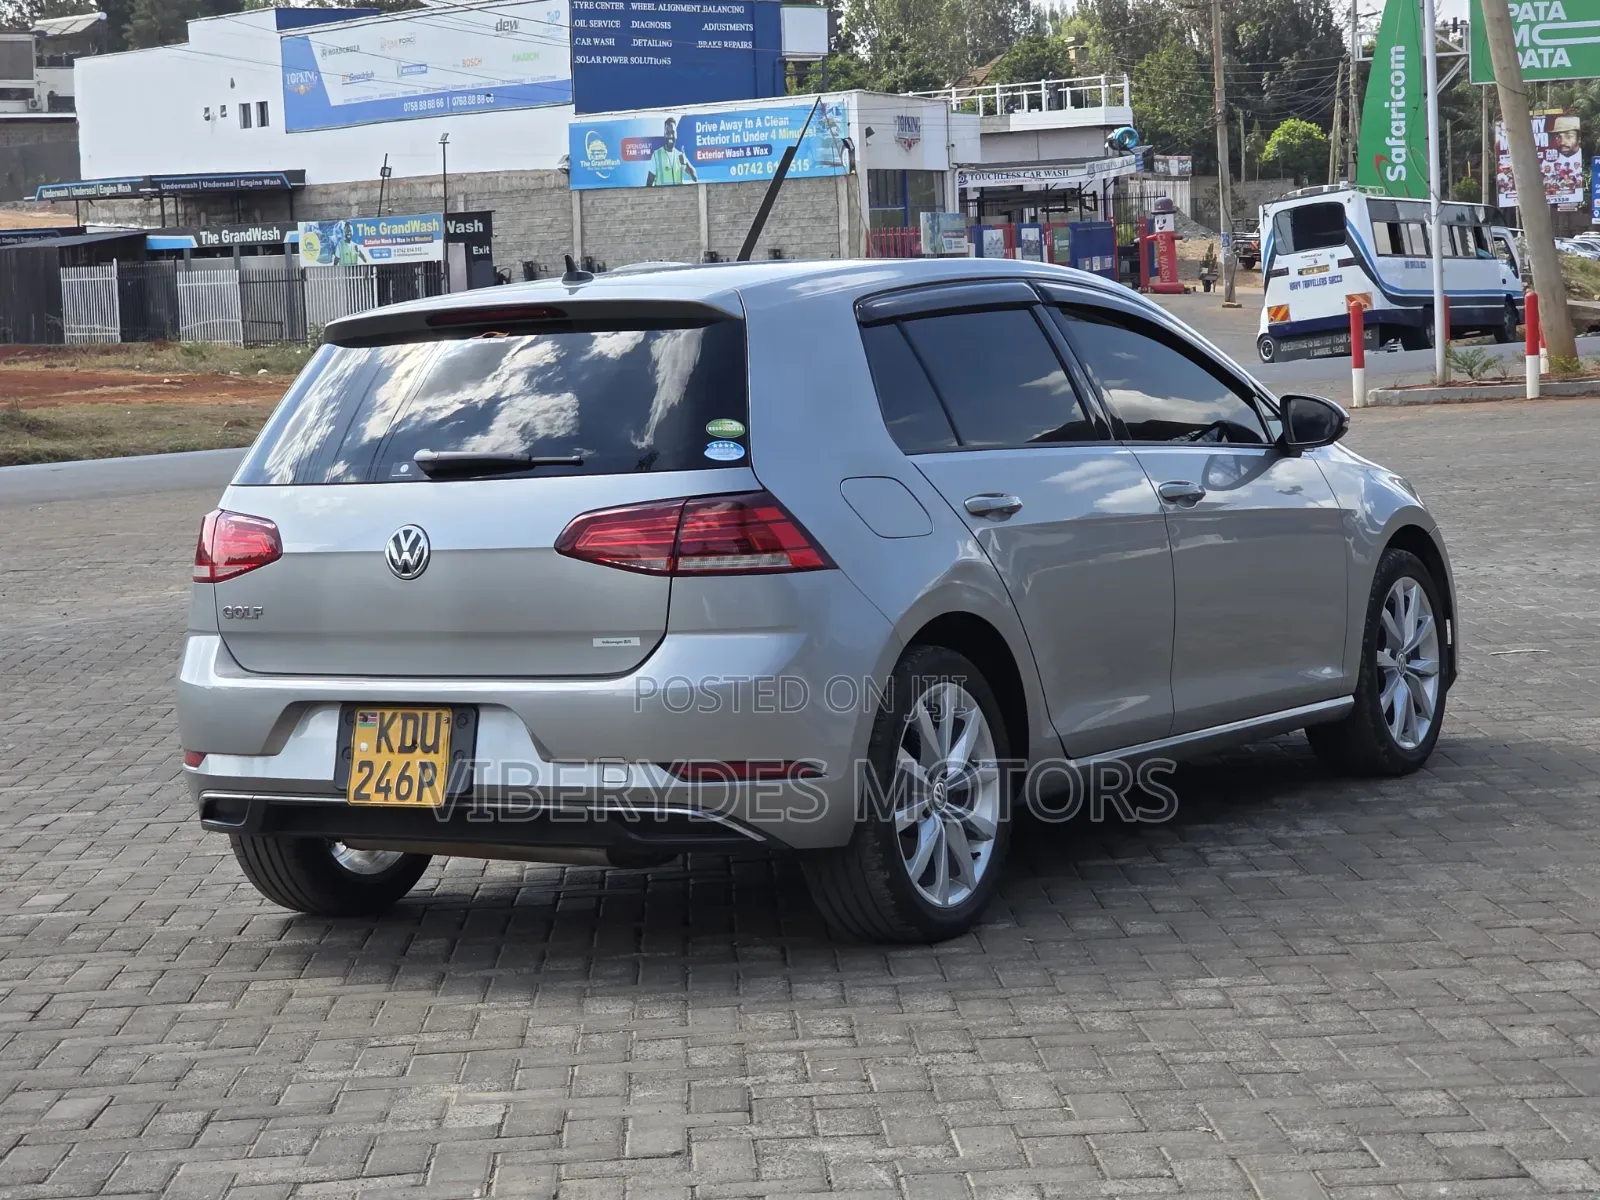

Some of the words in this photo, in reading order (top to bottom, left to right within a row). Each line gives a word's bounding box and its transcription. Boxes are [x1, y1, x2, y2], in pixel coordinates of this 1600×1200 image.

[595, 2, 625, 10] CENTER
[658, 3, 701, 12] ALIGNMENT
[589, 19, 621, 28] SERVICE
[593, 38, 615, 46] WASH
[723, 41, 753, 49] REPAIRS
[461, 57, 482, 68] BOSCH
[602, 56, 629, 64] POWER
[630, 56, 672, 65] SOLUTIONS
[1384, 45, 1407, 182] Safaricom
[696, 121, 718, 133] Drive
[719, 119, 743, 132] Away
[744, 117, 754, 129] In
[755, 117, 762, 128] A
[764, 115, 789, 127] Clean
[696, 134, 730, 146] Exterior
[732, 132, 741, 144] In
[743, 130, 769, 143] Under
[770, 129, 776, 140] 4
[697, 150, 725, 160] Exterior
[725, 148, 745, 158] Wash
[745, 147, 751, 157] &
[753, 146, 769, 156] Wax
[580, 160, 590, 168] The
[737, 162, 763, 176] 0742
[970, 172, 1021, 181] TOUCHLESS
[1023, 170, 1041, 179] CAR
[1043, 169, 1069, 178] WASH
[42, 187, 69, 199] Underwash
[71, 185, 97, 196] Underseal
[99, 184, 117, 195] Engine
[117, 183, 132, 193] Wash
[161, 182, 198, 190] Underwash
[202, 180, 236, 189] Underseal
[240, 179, 262, 187] Engine
[263, 178, 281, 186] Wash
[356, 223, 376, 237] The
[379, 218, 439, 235] GrandWash
[199, 231, 220, 245] The
[221, 226, 281, 244] GrandWash
[472, 245, 490, 255] Exit
[1157, 235, 1168, 253] CAR
[1160, 255, 1171, 282] WASH
[222, 605, 264, 620] GOLF
[376, 711, 443, 755] KDU
[353, 760, 438, 802] 246P
